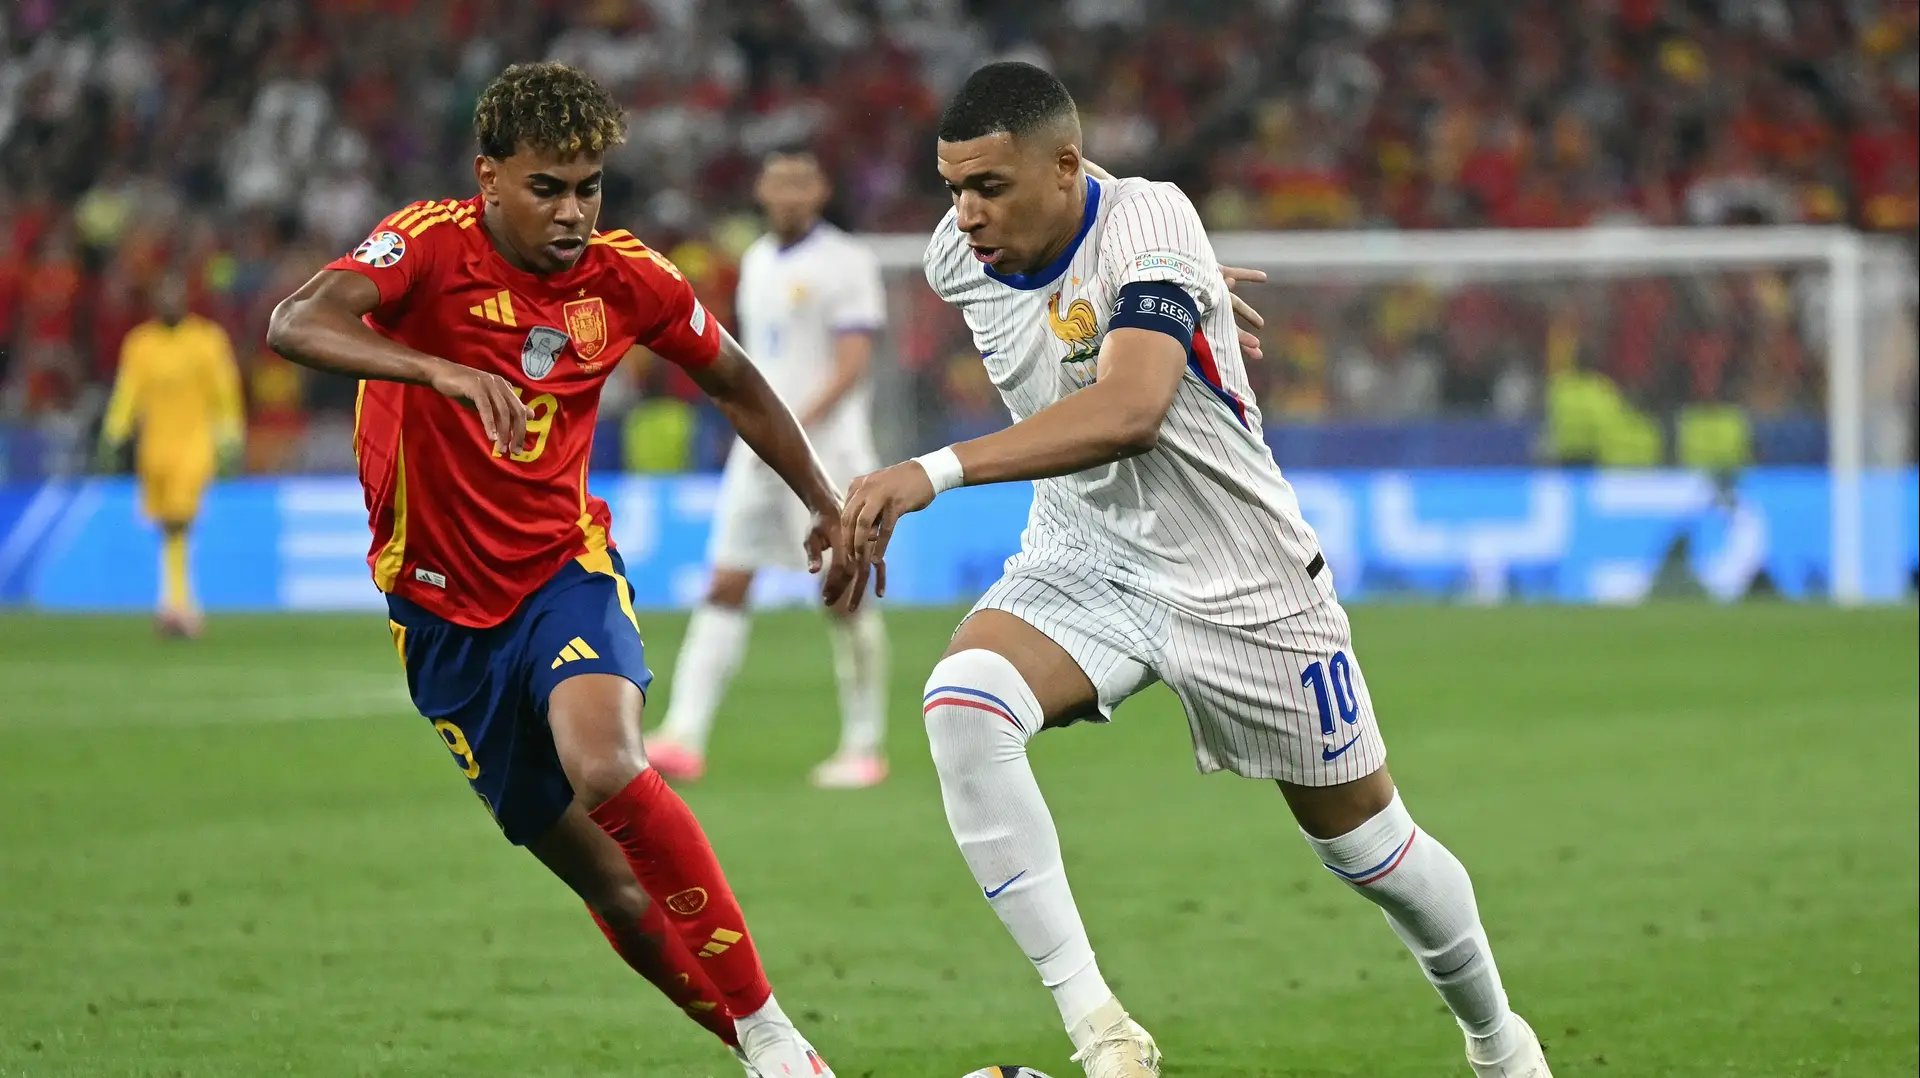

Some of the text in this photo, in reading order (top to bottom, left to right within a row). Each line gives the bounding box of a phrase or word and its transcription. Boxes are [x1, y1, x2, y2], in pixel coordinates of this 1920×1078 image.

[1136, 258, 1195, 278] FOUNDATION
[1160, 302, 1194, 330] RESPE
[1301, 651, 1359, 735] 10
